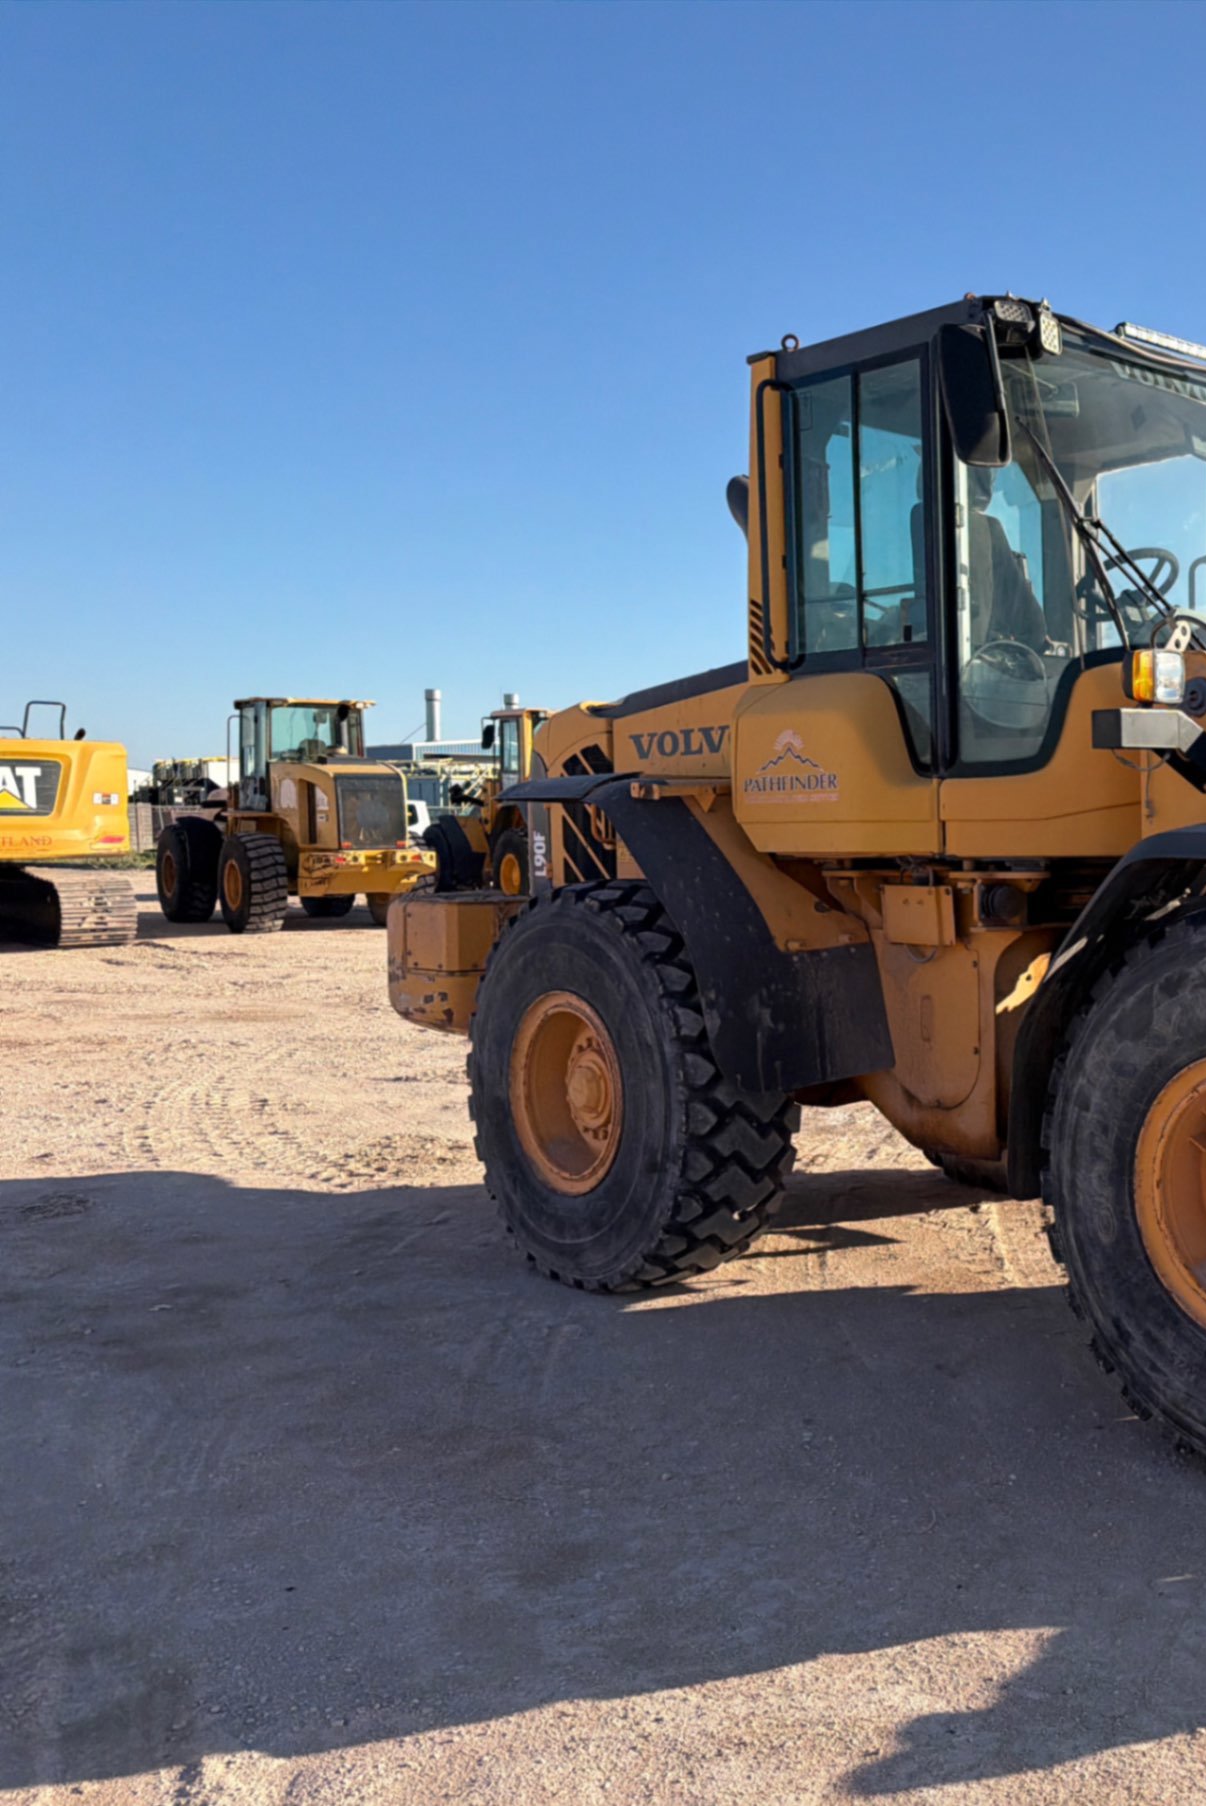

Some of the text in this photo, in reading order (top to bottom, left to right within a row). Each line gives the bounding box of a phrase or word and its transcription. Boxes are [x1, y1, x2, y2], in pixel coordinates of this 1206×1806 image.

[629, 725, 731, 759] VOLV
[744, 773, 837, 793] PATHFINDER
[533, 831, 547, 877] L90F
